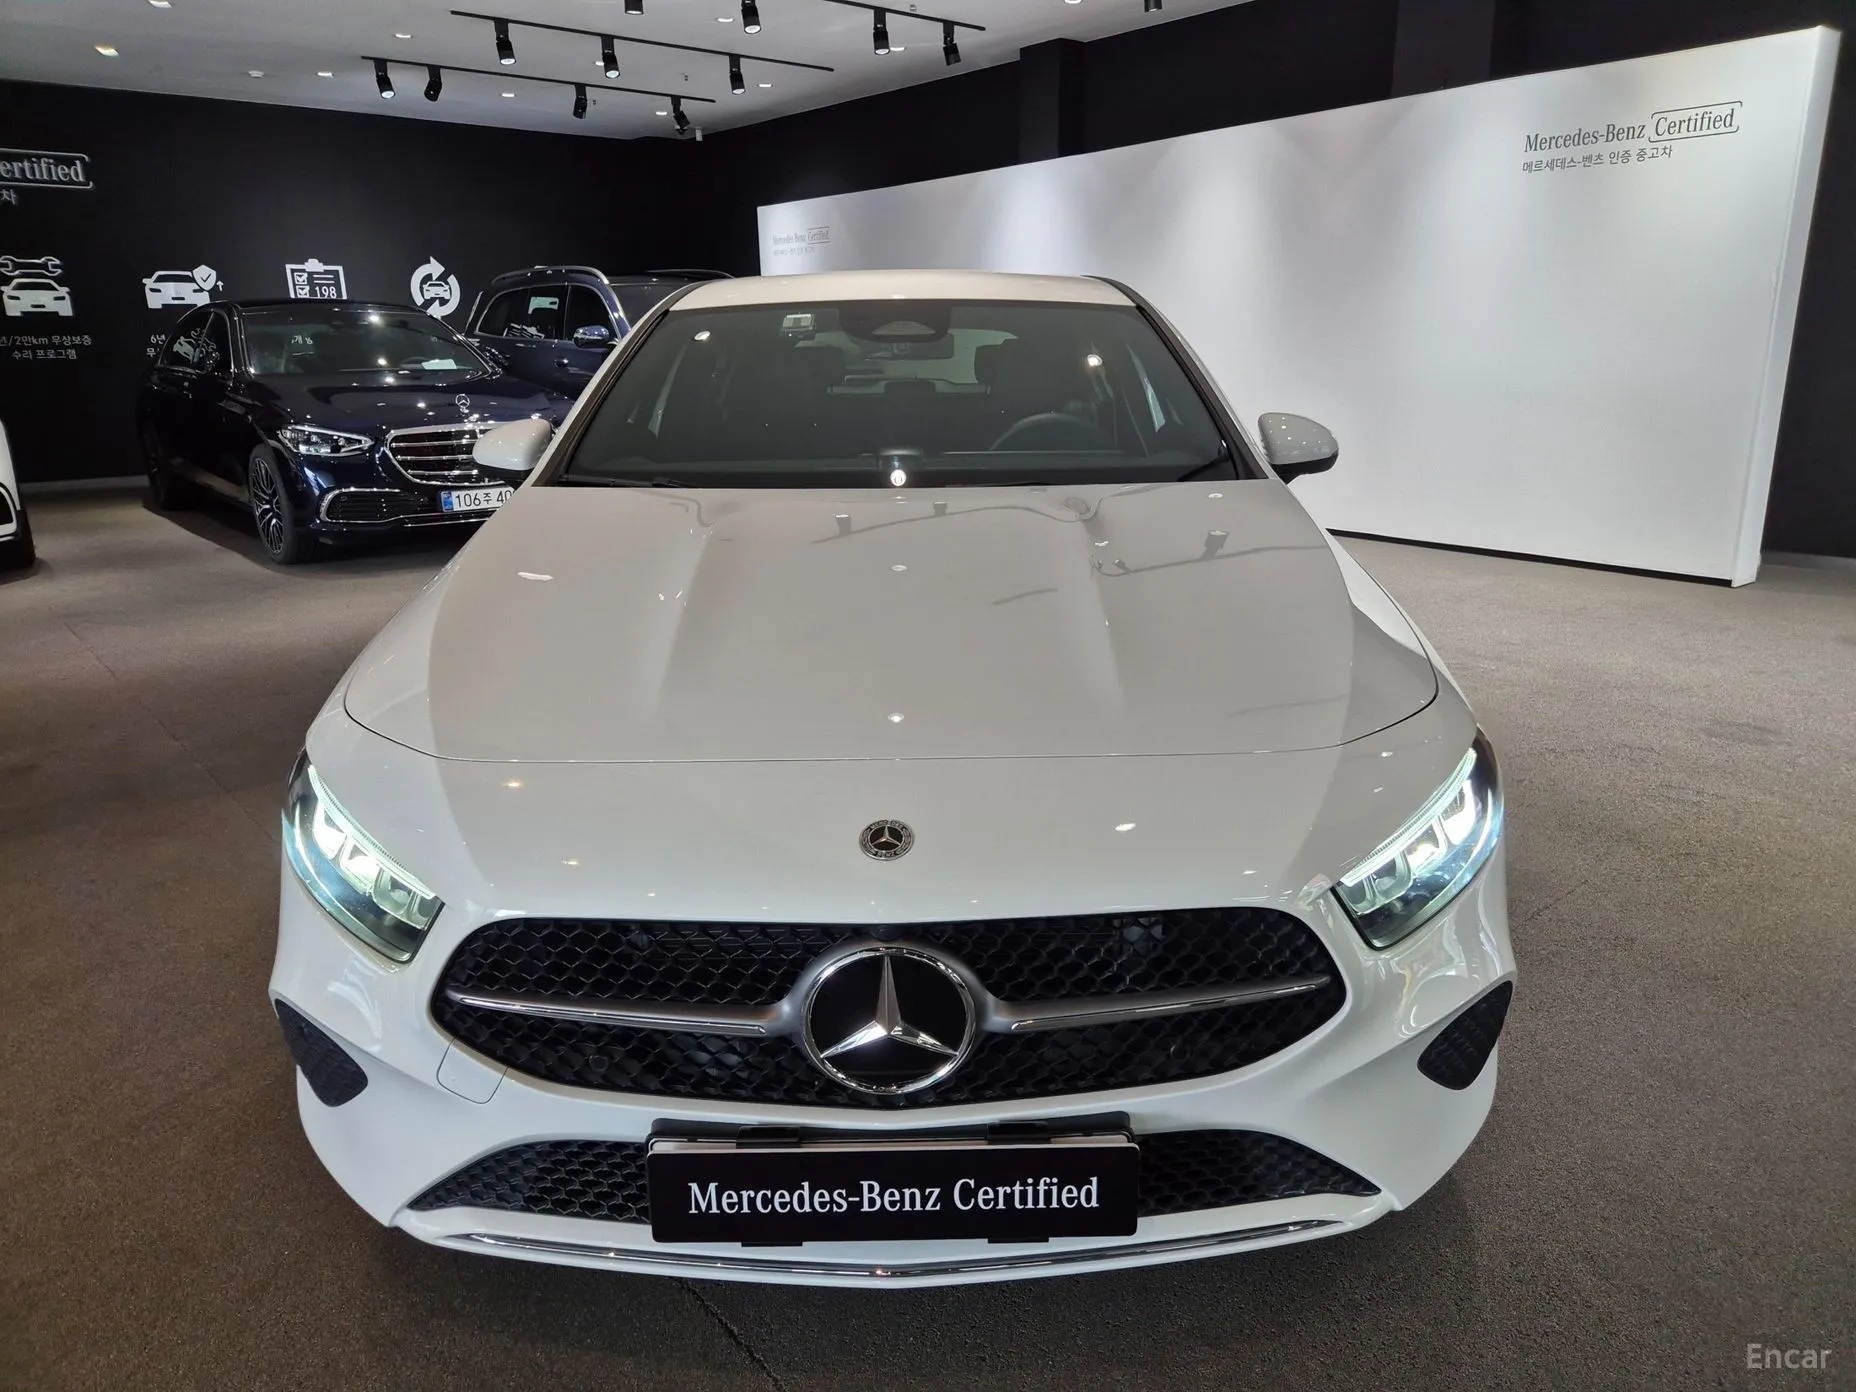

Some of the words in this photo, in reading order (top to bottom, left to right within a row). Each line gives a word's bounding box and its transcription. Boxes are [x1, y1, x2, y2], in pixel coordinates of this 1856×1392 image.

[1523, 122, 1646, 153] Mercedes-Benz
[1654, 108, 1735, 137] Certified
[0, 157, 86, 182] ertified
[1522, 152, 1604, 174] 메르세데스-벤츠
[1608, 149, 1632, 166] 인증
[1635, 145, 1673, 162] 중고차
[315, 286, 337, 299] 198
[52, 334, 92, 346] 무상보증
[12, 349, 33, 360] 수리
[36, 348, 77, 360] 프로그램
[455, 492, 493, 508] 106주
[496, 489, 515, 504] 40
[688, 1180, 941, 1214] Mercedes-Benz
[953, 1177, 1100, 1211] Certified
